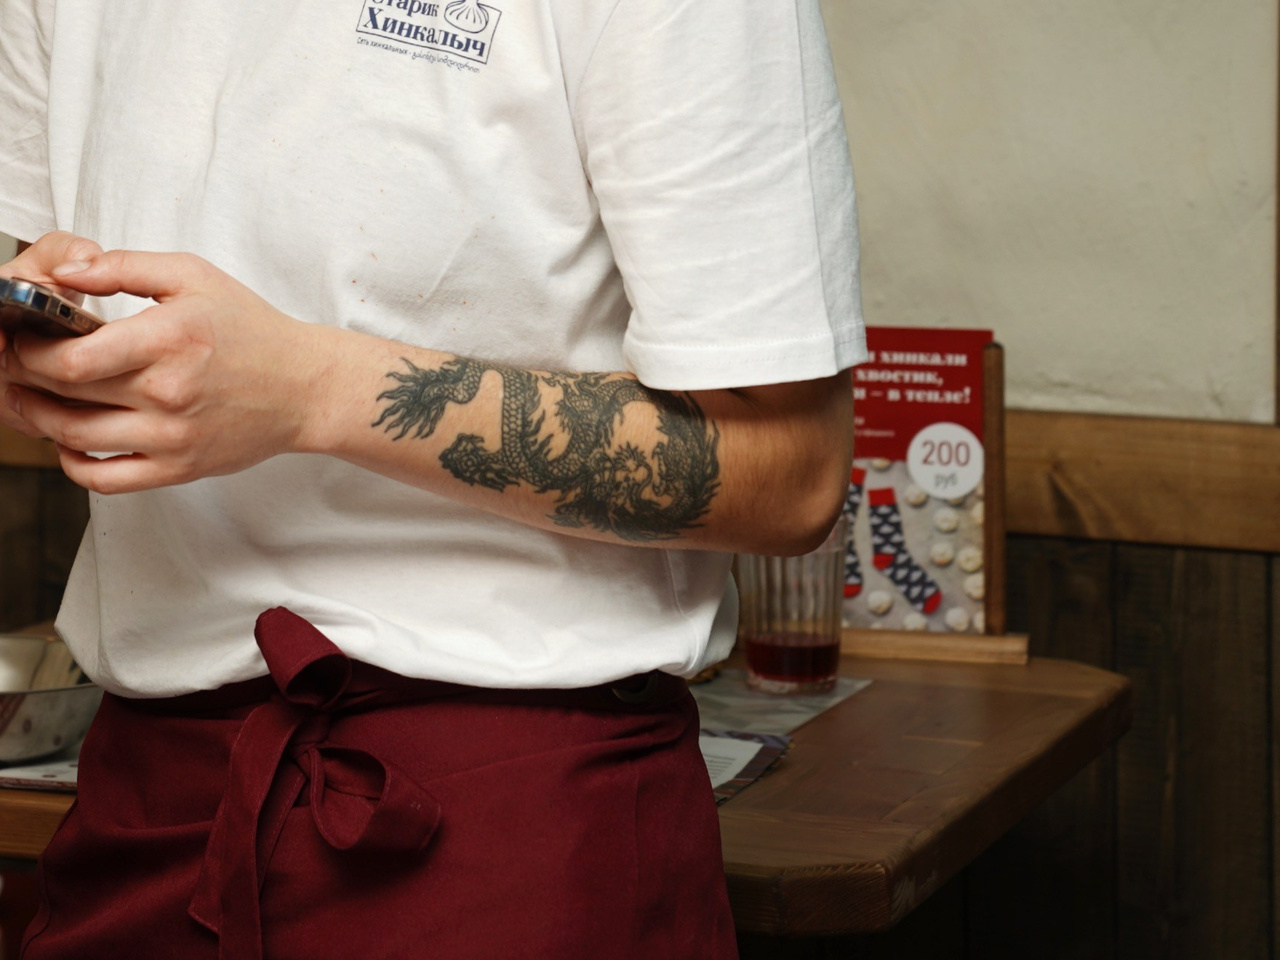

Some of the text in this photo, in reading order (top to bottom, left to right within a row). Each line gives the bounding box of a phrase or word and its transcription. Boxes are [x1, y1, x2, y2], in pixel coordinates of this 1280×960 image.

[362, 6, 486, 57] Хинкалыч
[357, 37, 408, 54] Сеть хинкальных
[922, 440, 971, 467] 200
[933, 472, 958, 489] руб
